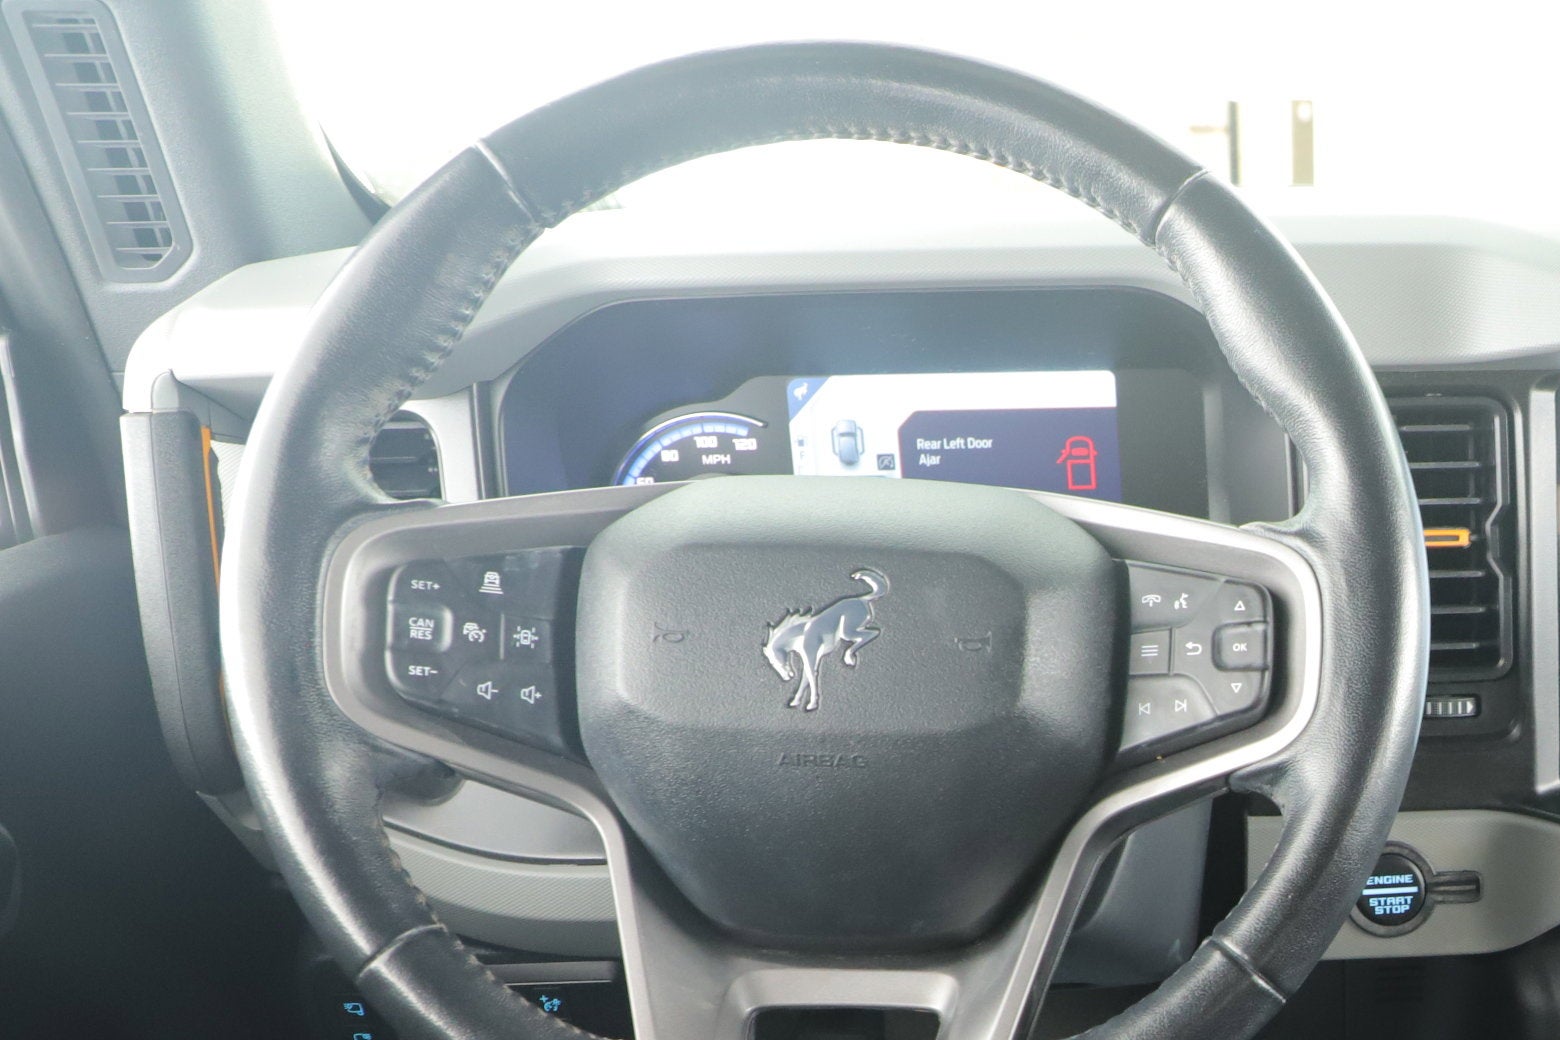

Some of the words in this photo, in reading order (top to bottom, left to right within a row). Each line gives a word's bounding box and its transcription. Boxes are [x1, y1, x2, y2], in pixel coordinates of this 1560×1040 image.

[916, 438, 941, 450] Rear
[943, 437, 966, 450] Left
[967, 436, 993, 449] Door
[702, 454, 731, 465] MPH
[919, 453, 941, 467] Ajar
[410, 579, 440, 591] SET+
[408, 617, 435, 628] CAN
[409, 629, 433, 640] RES
[1232, 643, 1248, 652] OK
[777, 752, 868, 768] AIRBAG
[1366, 873, 1414, 886] ENGINE
[1369, 896, 1413, 907] START
[1374, 905, 1410, 915] STOP
